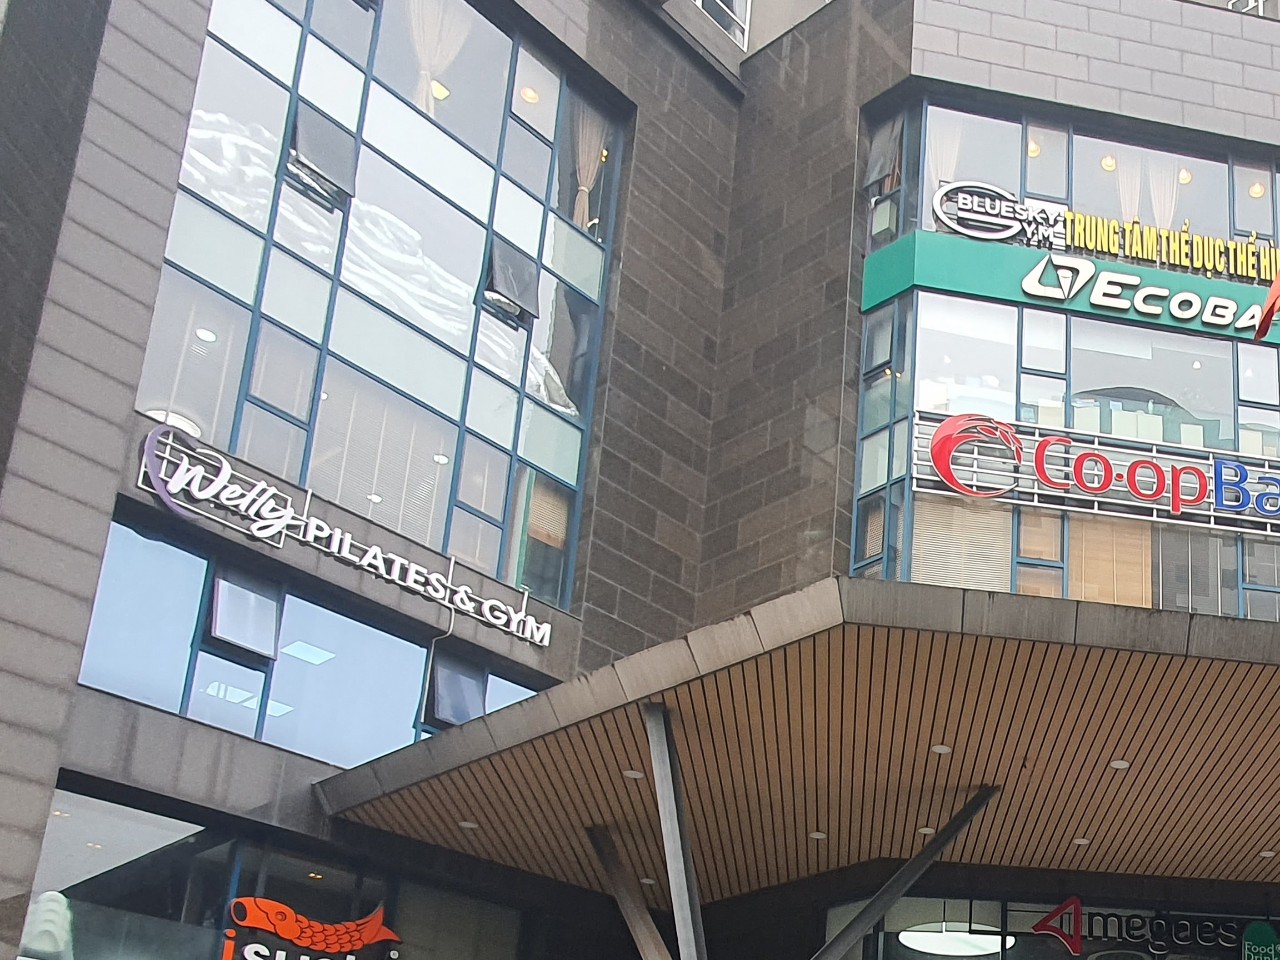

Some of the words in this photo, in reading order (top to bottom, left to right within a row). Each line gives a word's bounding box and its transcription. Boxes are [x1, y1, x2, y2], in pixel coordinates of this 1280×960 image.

[957, 192, 1059, 223] BLUESKY
[1064, 211, 1119, 255] TRUNG
[1123, 215, 1158, 261] TÂM
[1159, 219, 1190, 267] THỂ
[1193, 234, 1227, 279] DỤC
[1227, 230, 1257, 279] THỂ
[166, 447, 304, 538] Welly
[306, 516, 447, 601] PILATES
[451, 584, 477, 613] &
[481, 598, 552, 647] GYM
[1244, 941, 1275, 955] Food
